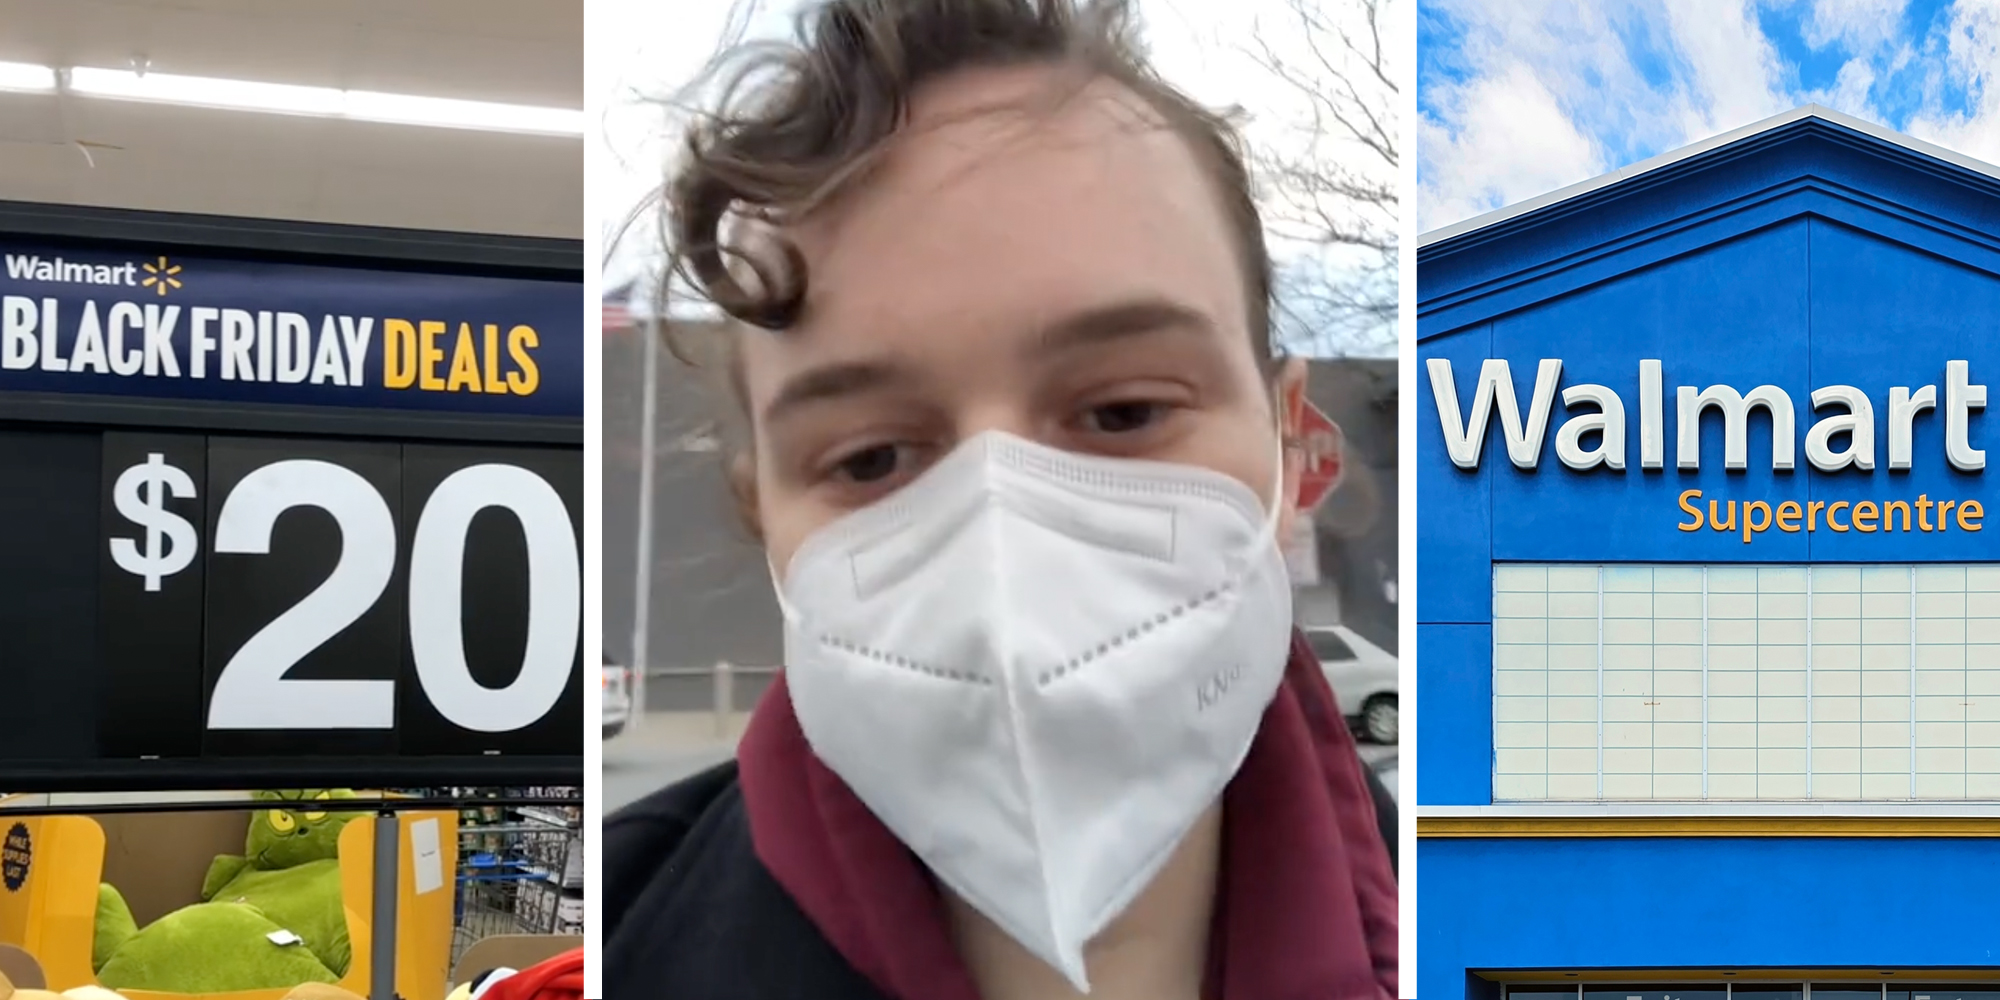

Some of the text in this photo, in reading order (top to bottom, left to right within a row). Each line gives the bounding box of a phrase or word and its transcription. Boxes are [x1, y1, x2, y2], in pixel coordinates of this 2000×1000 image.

[5, 254, 137, 287] Walmart
[1, 296, 540, 397] BLACK FRIDAY DEALS
[1426, 358, 1987, 472] Walmart
[1678, 489, 1984, 543] Supercentre
[109, 453, 581, 732] $20
